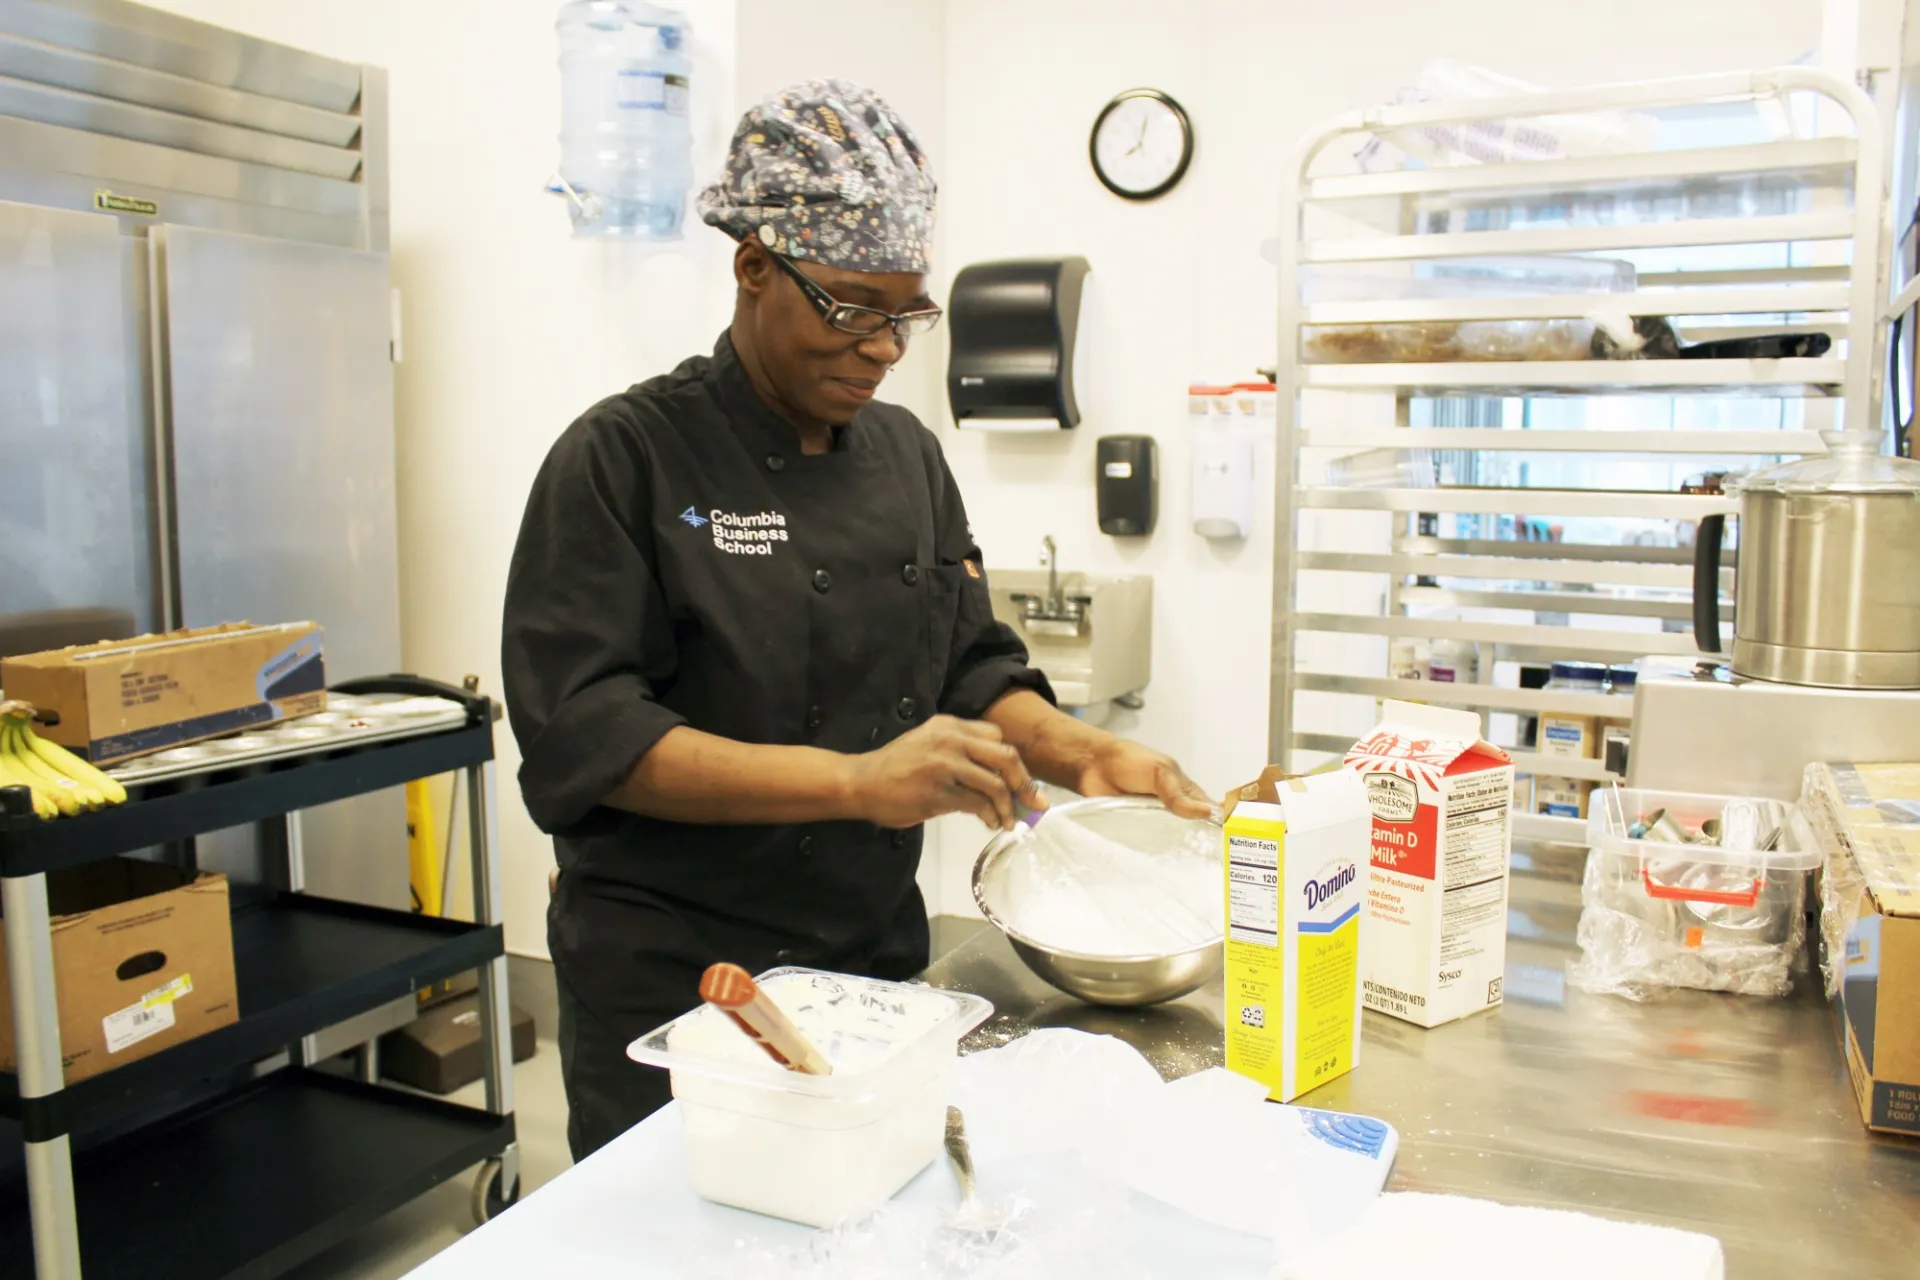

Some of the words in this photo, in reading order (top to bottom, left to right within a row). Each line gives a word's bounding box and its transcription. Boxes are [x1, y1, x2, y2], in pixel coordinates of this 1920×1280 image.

[710, 509, 786, 526] Columbia
[712, 523, 789, 541] Business
[713, 537, 773, 555] School
[1229, 837, 1257, 849] Nutrition
[1258, 840, 1277, 851] Facts
[1407, 832, 1418, 848] D
[1371, 844, 1398, 866] Milk
[1230, 871, 1255, 881] Calories
[1262, 874, 1278, 884] 120
[1304, 863, 1355, 910] Domino
[1438, 969, 1462, 983] Sysco
[1408, 993, 1426, 1007] NETO
[1887, 1109, 1915, 1122] FOOD
